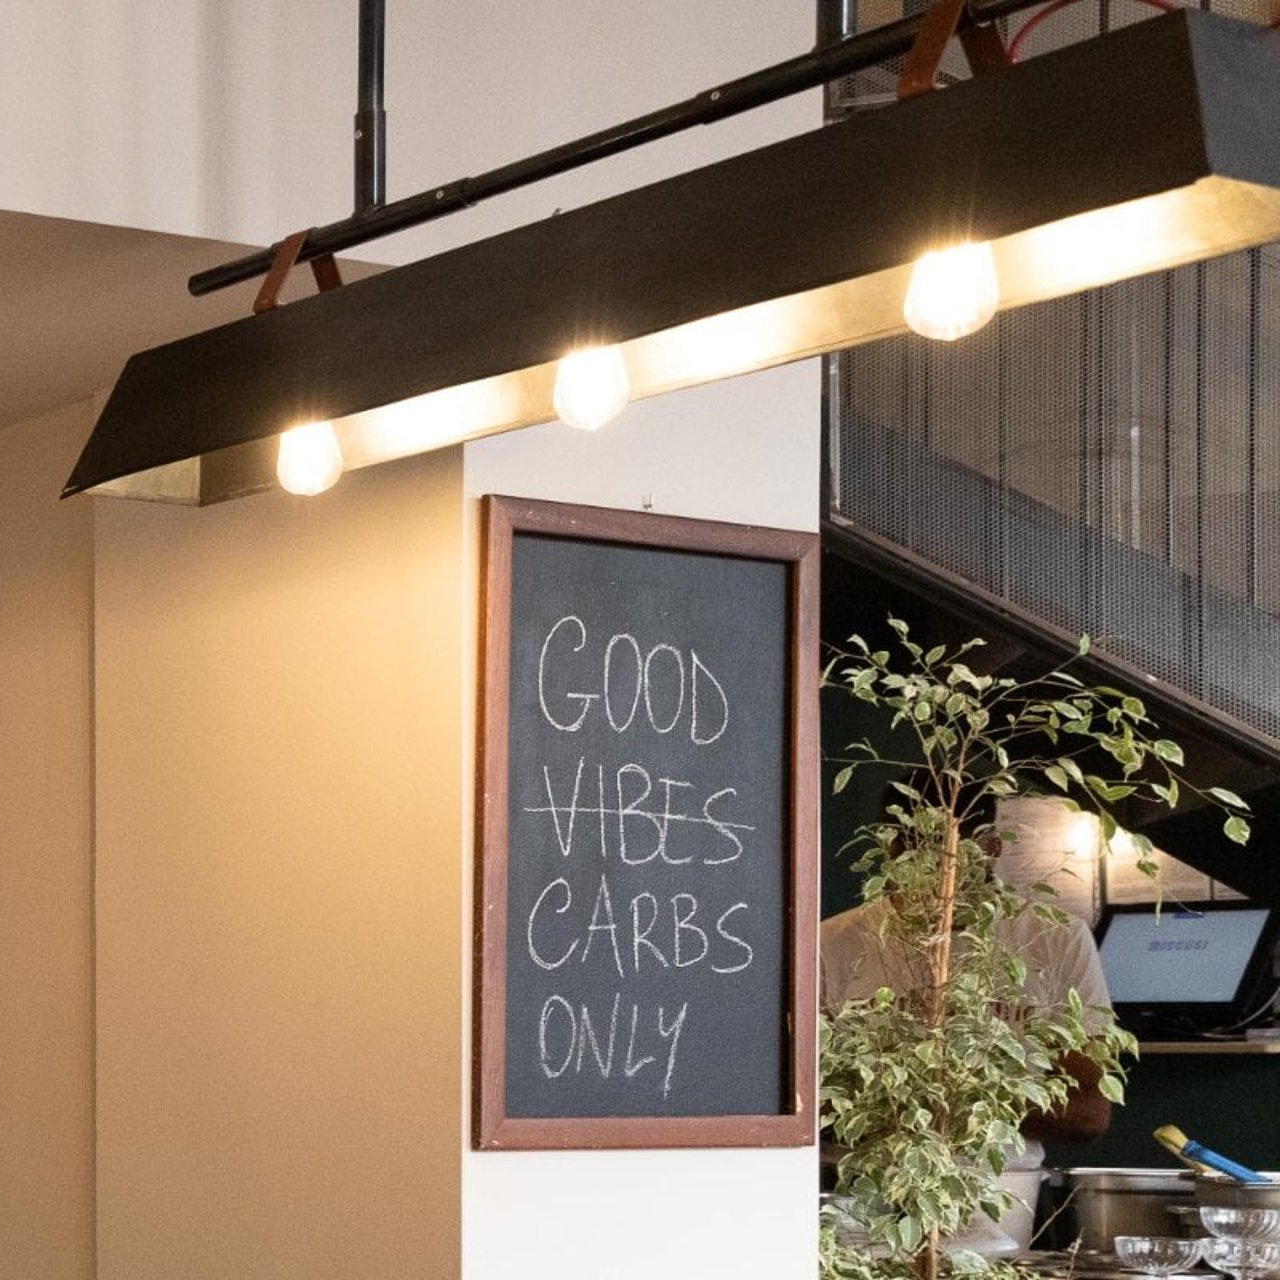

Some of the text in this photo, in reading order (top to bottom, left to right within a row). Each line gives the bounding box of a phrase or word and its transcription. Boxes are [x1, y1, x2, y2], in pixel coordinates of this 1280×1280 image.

[538, 615, 729, 746] GOOD
[543, 755, 743, 866] VIBES
[526, 873, 754, 978] CARBS
[539, 992, 688, 1100] ONLY
